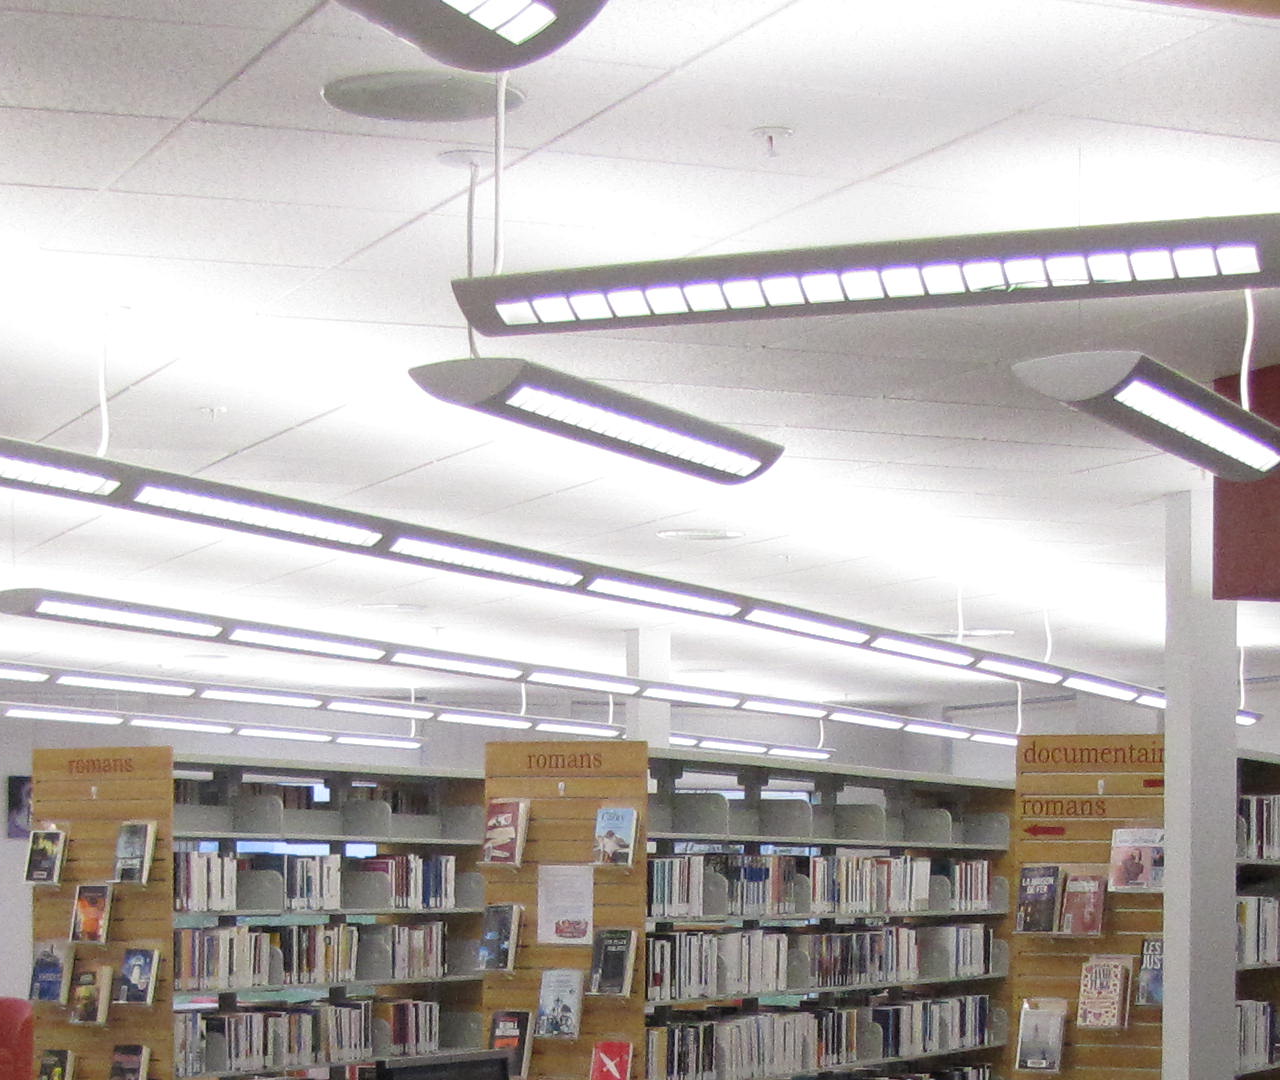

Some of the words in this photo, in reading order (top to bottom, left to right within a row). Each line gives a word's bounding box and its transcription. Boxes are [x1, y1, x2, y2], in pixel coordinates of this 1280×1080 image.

[68, 757, 134, 773] romans
[526, 750, 602, 769] romans
[1021, 799, 1106, 816] romans
